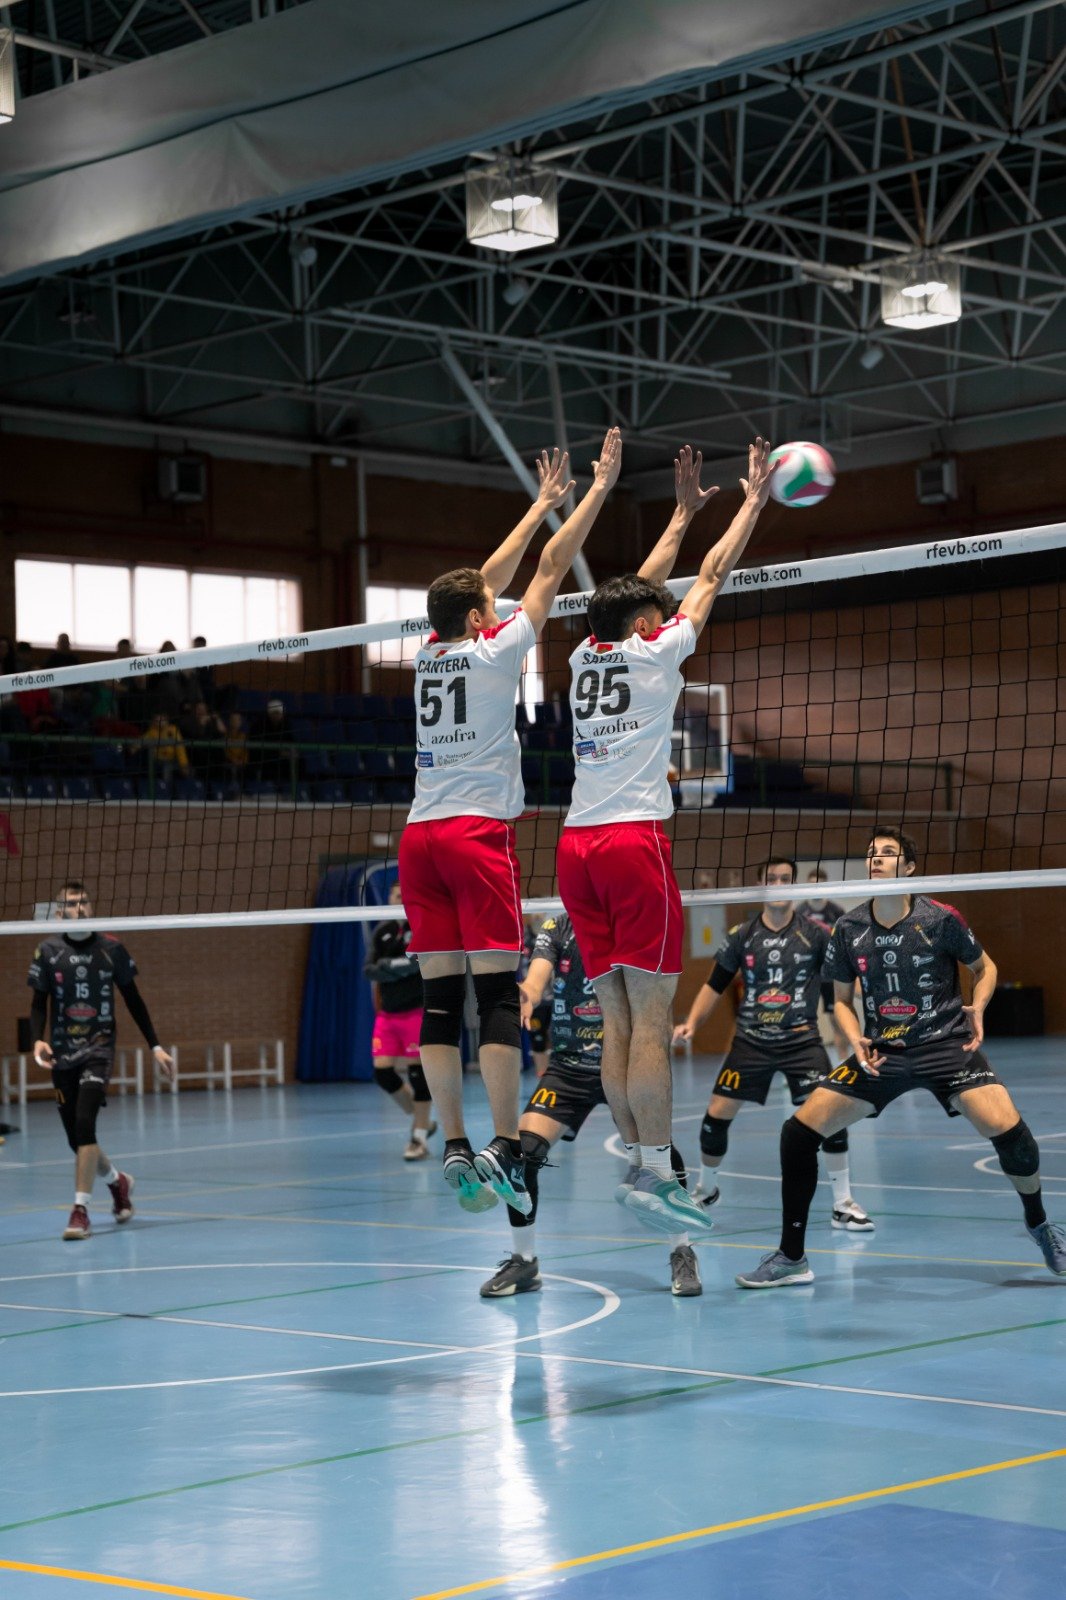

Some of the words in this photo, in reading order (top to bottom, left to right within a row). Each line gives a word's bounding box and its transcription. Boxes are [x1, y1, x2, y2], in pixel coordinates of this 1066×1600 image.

[926, 538, 1003, 560] rfevb.com
[732, 566, 802, 587] rfevb.com
[558, 595, 590, 610] rfevb
[401, 618, 431, 633] rfevb
[257, 636, 309, 653] rfevb.com
[129, 655, 176, 671] rfevb.com
[417, 657, 471, 673] CANTERA
[575, 665, 631, 720] 95
[420, 676, 467, 727] 51
[593, 718, 639, 736] azofra
[431, 729, 476, 745] azofra
[767, 968, 783, 984] 14
[885, 973, 900, 992] 11
[75, 982, 90, 999] 15
[583, 977, 596, 995] 2
